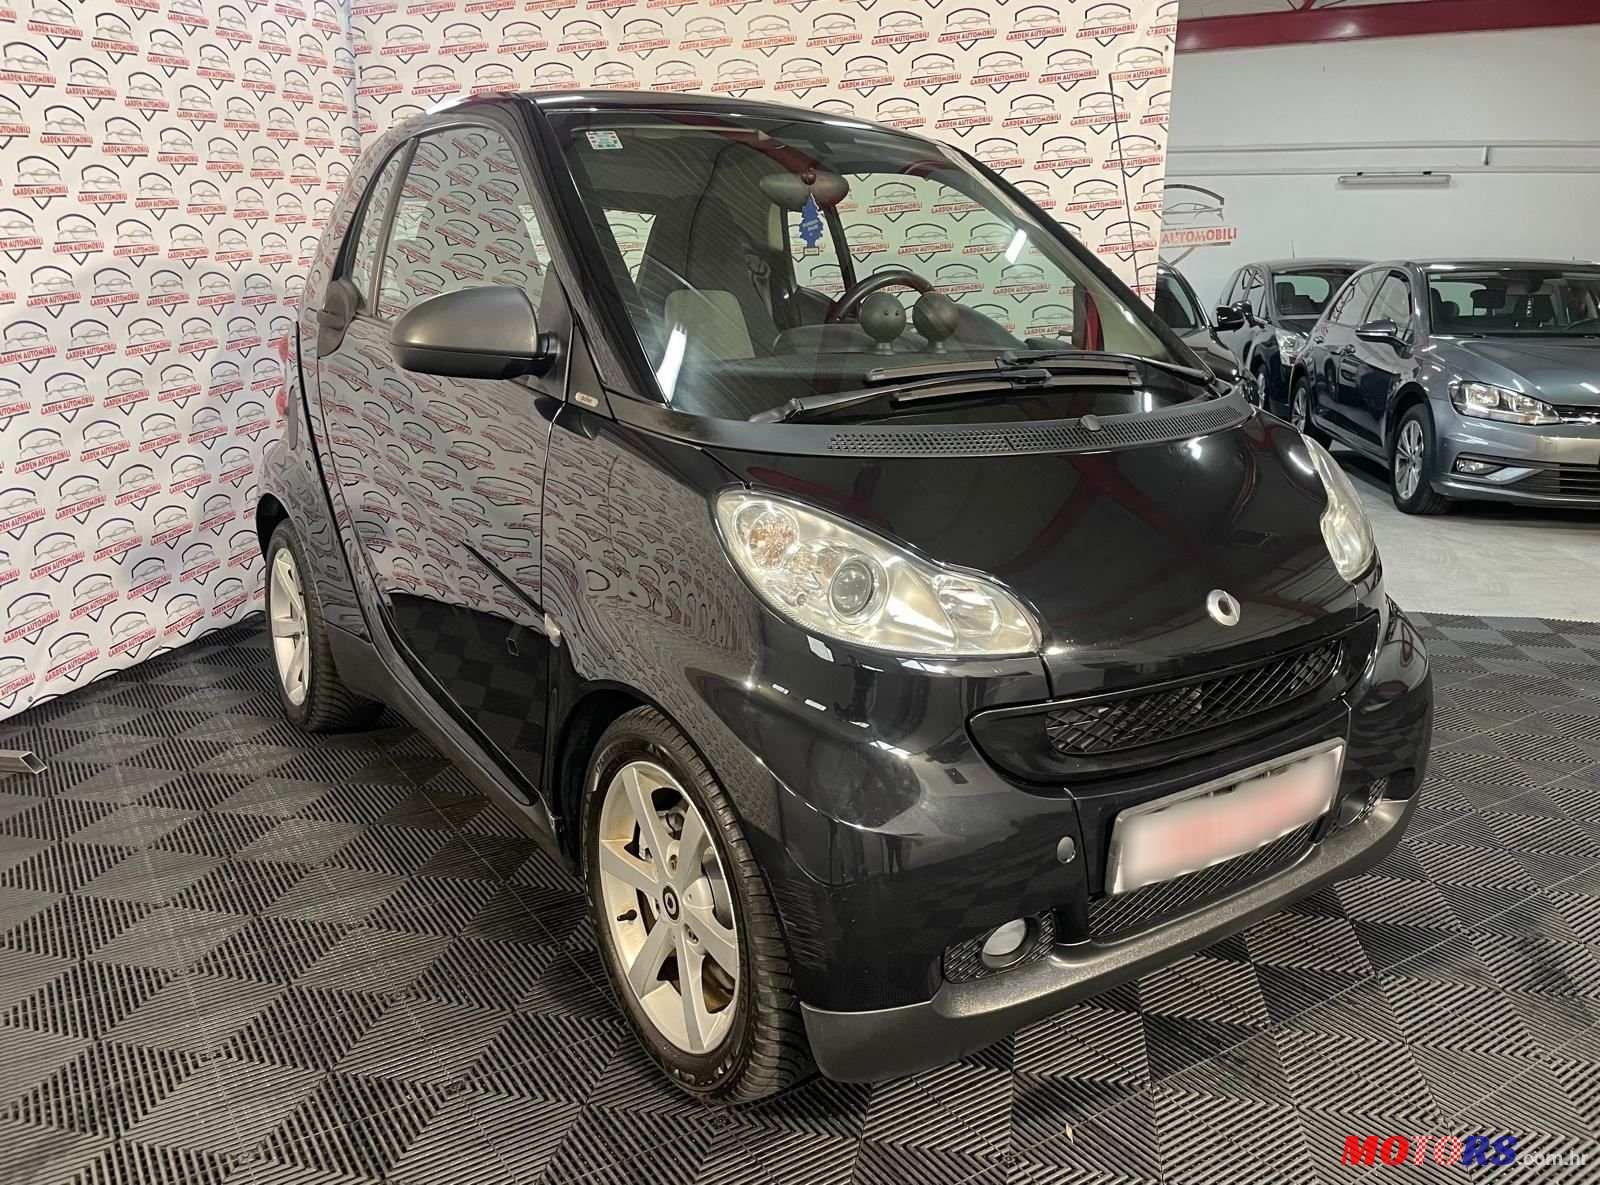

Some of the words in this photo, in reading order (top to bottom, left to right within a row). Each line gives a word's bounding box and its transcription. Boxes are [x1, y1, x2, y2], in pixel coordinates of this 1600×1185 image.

[426, 1, 456, 12] AUTOMOBILI
[485, 0, 516, 10] AUTOMOBILI
[961, 28, 997, 40] AUTOMOBILI
[1030, 26, 1067, 38] AUTOMOBILI
[1100, 23, 1138, 35] AUTOMOBILI
[700, 37, 733, 47] AUTOMOBILI
[763, 35, 797, 46] AUTOMOBILI
[828, 33, 863, 44] AUTOMOBILI
[894, 32, 930, 42] AUTOMOBILI
[401, 44, 430, 53] AUTOMOBILI
[458, 43, 489, 52] AUTOMOBILI
[517, 41, 548, 51] AUTOMOBILI
[578, 40, 609, 50] AUTOMOBILI
[638, 38, 670, 49] AUTOMOBILI
[994, 72, 1030, 82] AUTOMOBILI
[1062, 69, 1099, 80] AUTOMOBILI
[1133, 67, 1170, 79] AUTOMOBILI
[796, 77, 829, 88] AUTOMOBILI
[860, 76, 895, 86] AUTOMOBILI
[926, 73, 962, 84] AUTOMOBILI
[432, 84, 462, 93] AUTOMOBILI
[732, 79, 766, 89] AUTOMOBILI
[893, 118, 926, 127] AUTOMOBILI
[958, 116, 993, 126] AUTOMOBILI
[1025, 114, 1061, 125] AUTOMOBILI
[990, 159, 1025, 168] AUTOMOBILI
[1057, 157, 1093, 167] AUTOMOBILI
[1126, 155, 1163, 166] AUTOMOBILI
[889, 202, 922, 212] AUTOMOBILI
[1089, 199, 1125, 209] AUTOMOBILI
[1162, 228, 1237, 244] AUTOMOBILI
[920, 243, 954, 252] AUTOMOBILI
